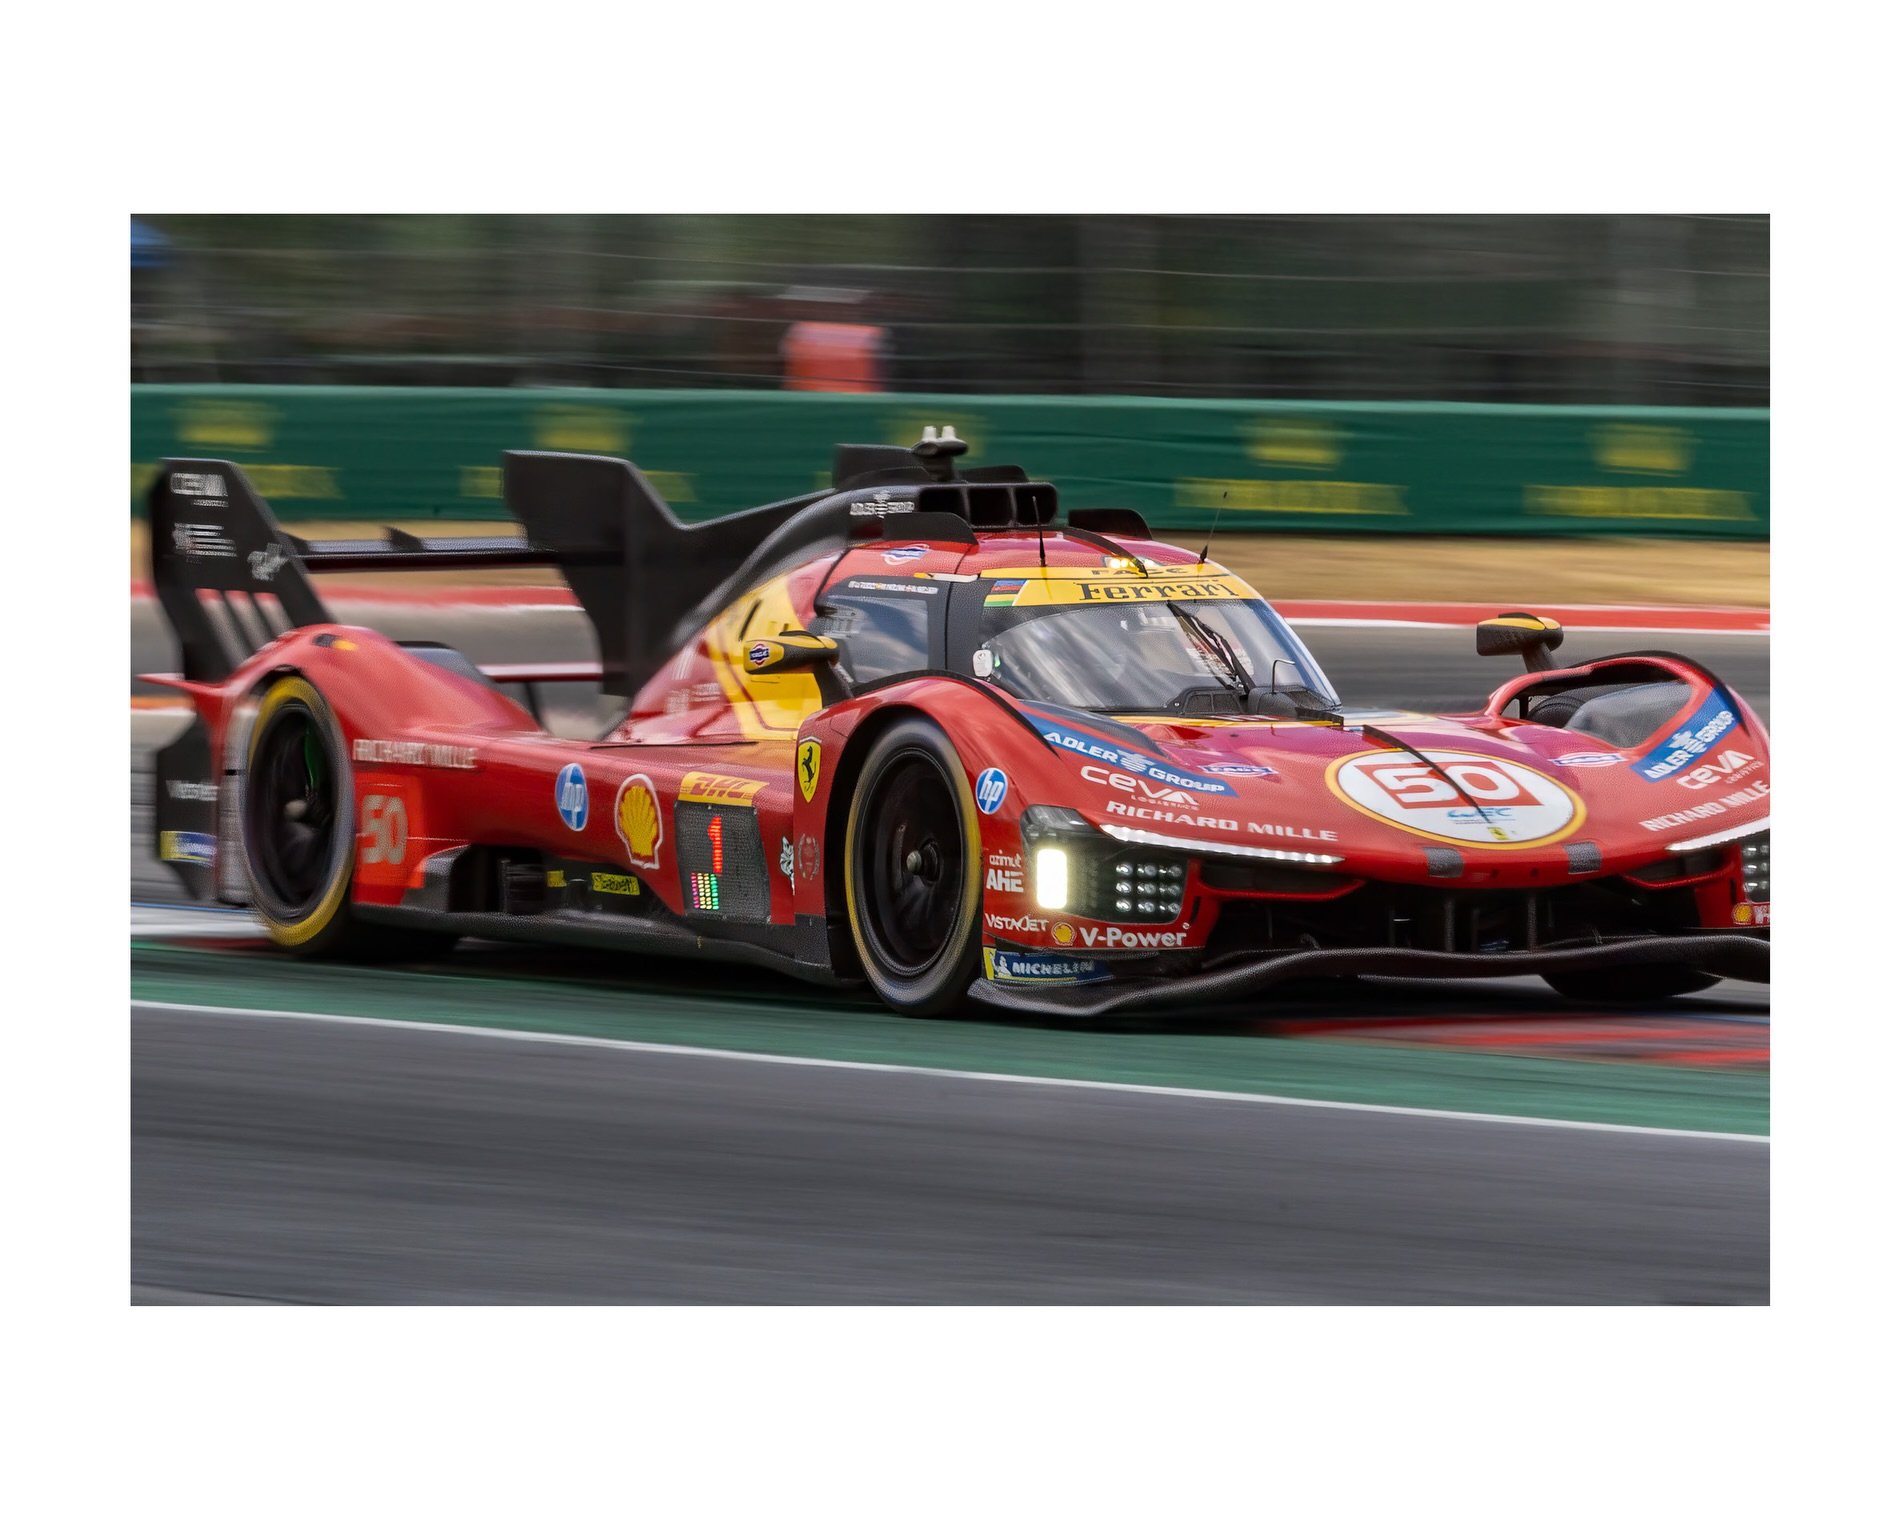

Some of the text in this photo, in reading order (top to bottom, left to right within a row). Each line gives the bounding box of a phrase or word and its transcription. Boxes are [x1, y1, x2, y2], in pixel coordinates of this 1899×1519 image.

[1073, 579, 1240, 601] Ferrari
[1043, 731, 1225, 792] ADLER GROUP
[979, 769, 1004, 813] hp
[1372, 765, 1520, 803] 50
[361, 794, 408, 865] 50
[1105, 800, 1339, 842] RICHARD MILLE
[1079, 926, 1187, 947] V-Power
[1011, 960, 1095, 976] MICHELIN
